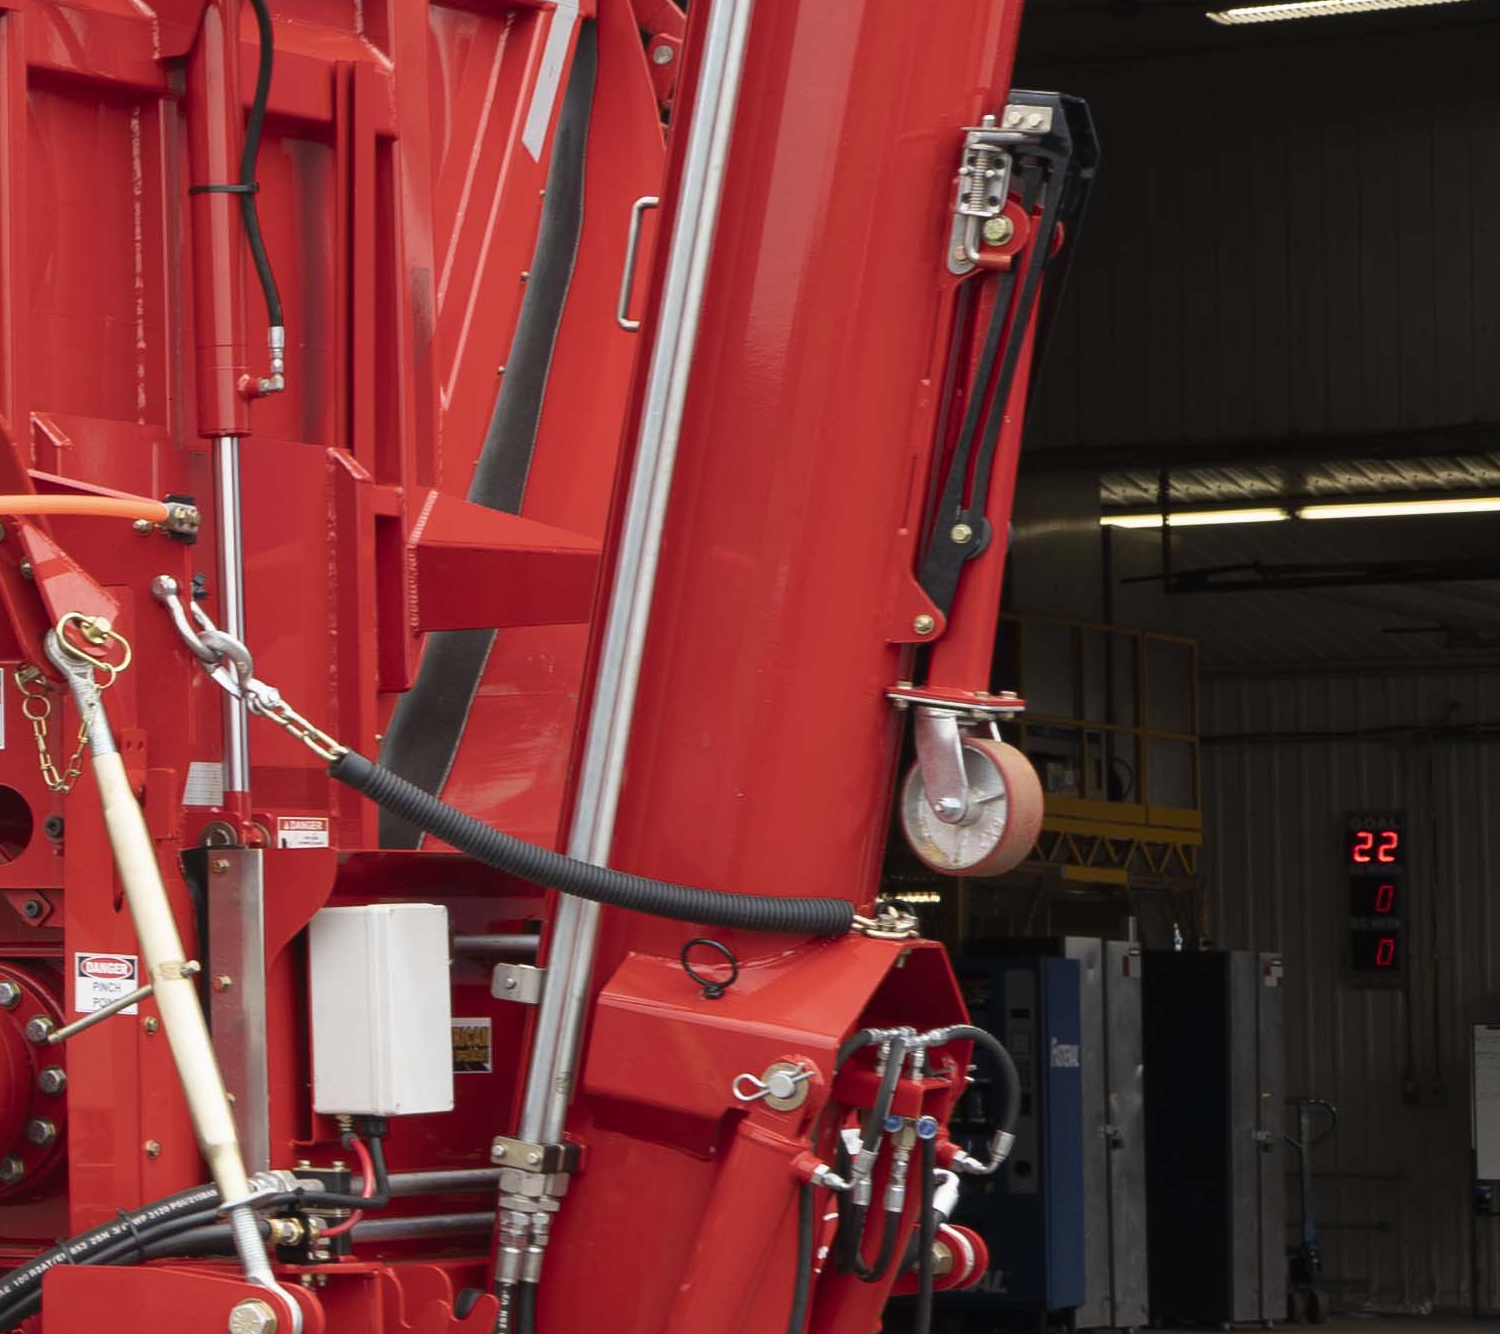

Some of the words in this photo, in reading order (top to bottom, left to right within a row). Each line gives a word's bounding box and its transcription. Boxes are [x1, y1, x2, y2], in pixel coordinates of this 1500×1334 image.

[1351, 830, 1400, 864] 22
[85, 961, 128, 975] DANGER
[92, 981, 122, 993] PINCH
